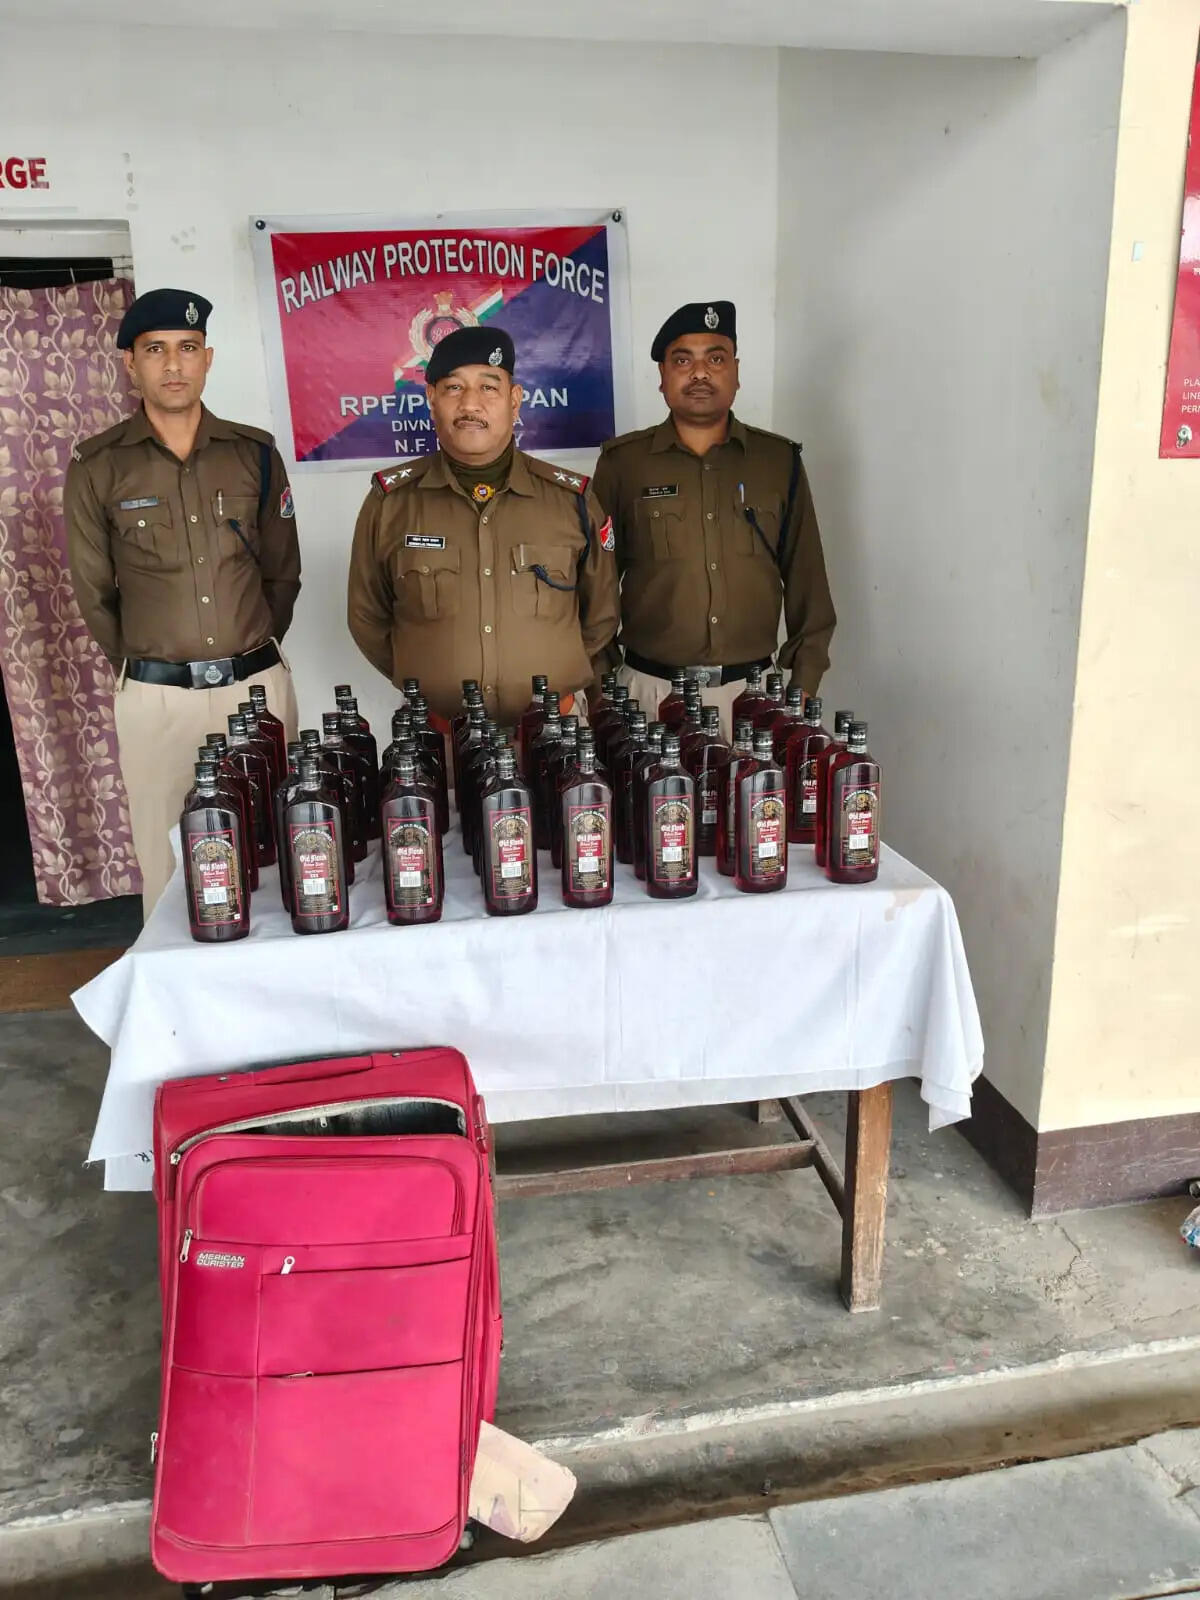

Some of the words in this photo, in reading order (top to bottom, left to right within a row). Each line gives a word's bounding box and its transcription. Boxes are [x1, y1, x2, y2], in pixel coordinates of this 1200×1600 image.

[0, 157, 49, 189] GE
[280, 247, 376, 314] RAILWAY
[383, 238, 525, 279] PROTECTION
[532, 248, 605, 304] FORCE
[391, 419, 436, 432] DIVN.
[394, 438, 430, 453] N.F.
[199, 1252, 245, 1263] MERICAN
